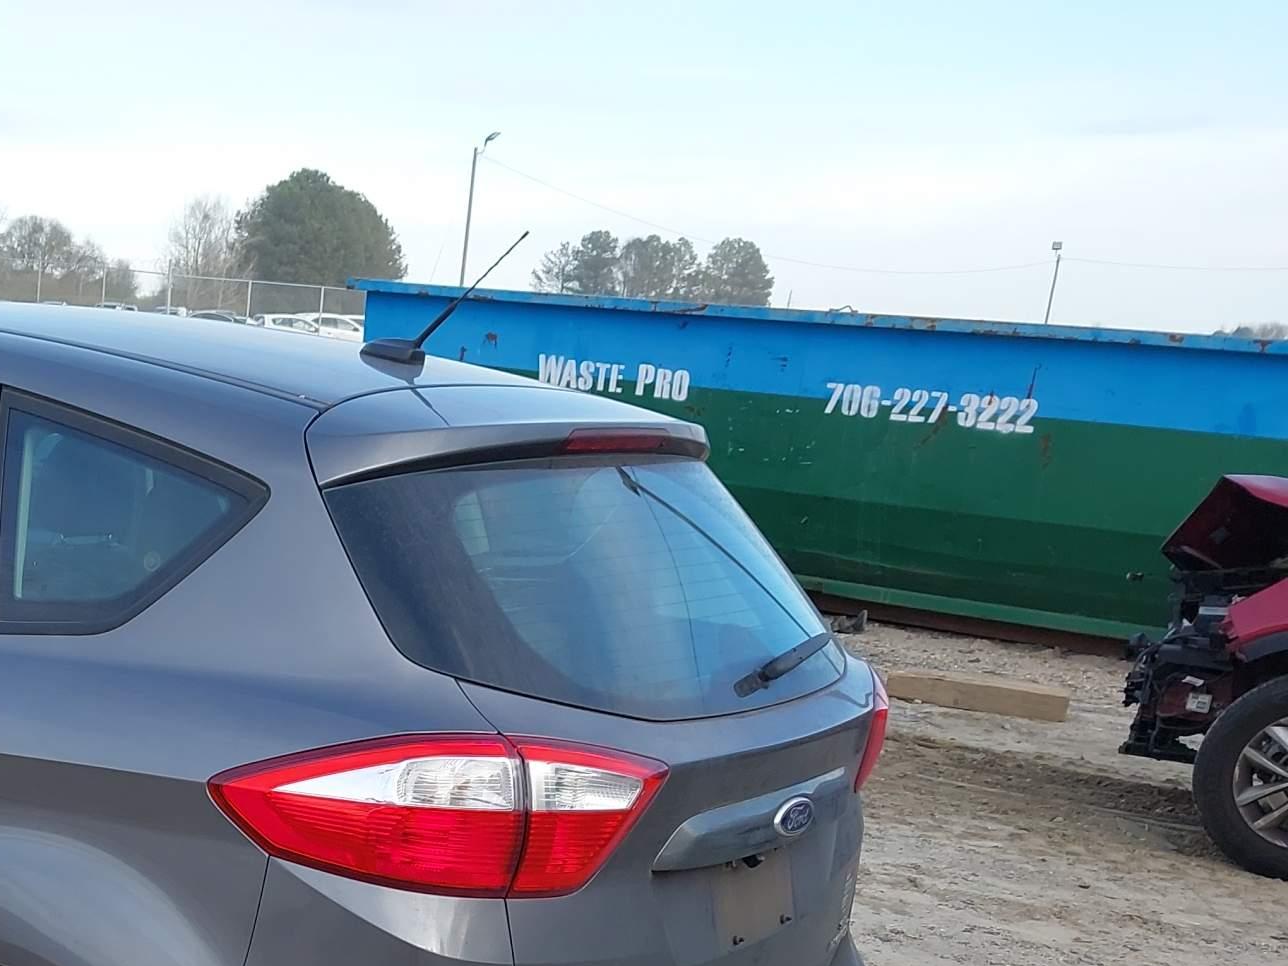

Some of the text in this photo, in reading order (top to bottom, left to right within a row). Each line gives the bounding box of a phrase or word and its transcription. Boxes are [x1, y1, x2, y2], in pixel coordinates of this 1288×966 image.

[538, 353, 691, 402] WASTE PRO
[824, 383, 1039, 434] 706-227-3222
